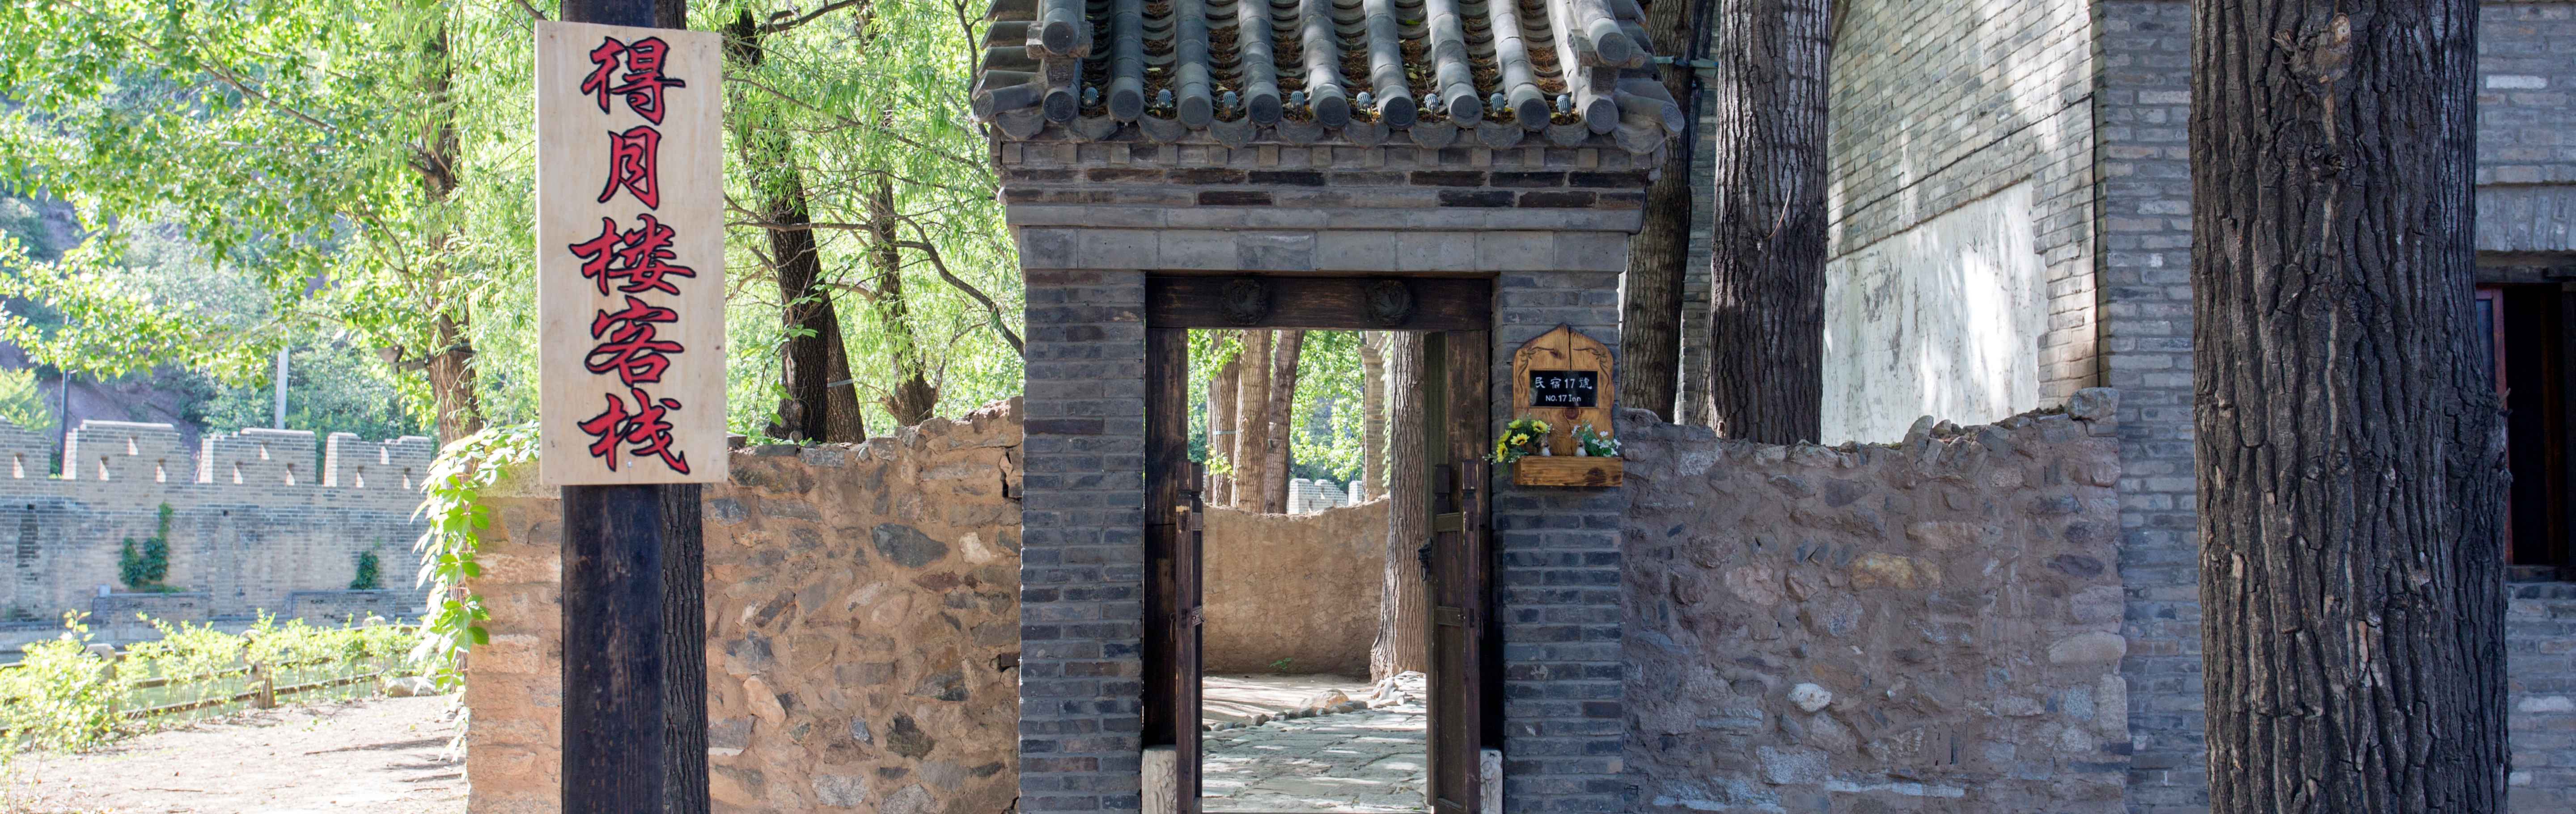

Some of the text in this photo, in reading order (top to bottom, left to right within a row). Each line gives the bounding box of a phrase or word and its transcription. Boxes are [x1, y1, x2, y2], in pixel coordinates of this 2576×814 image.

[569, 36, 696, 475] 得月楼客栈
